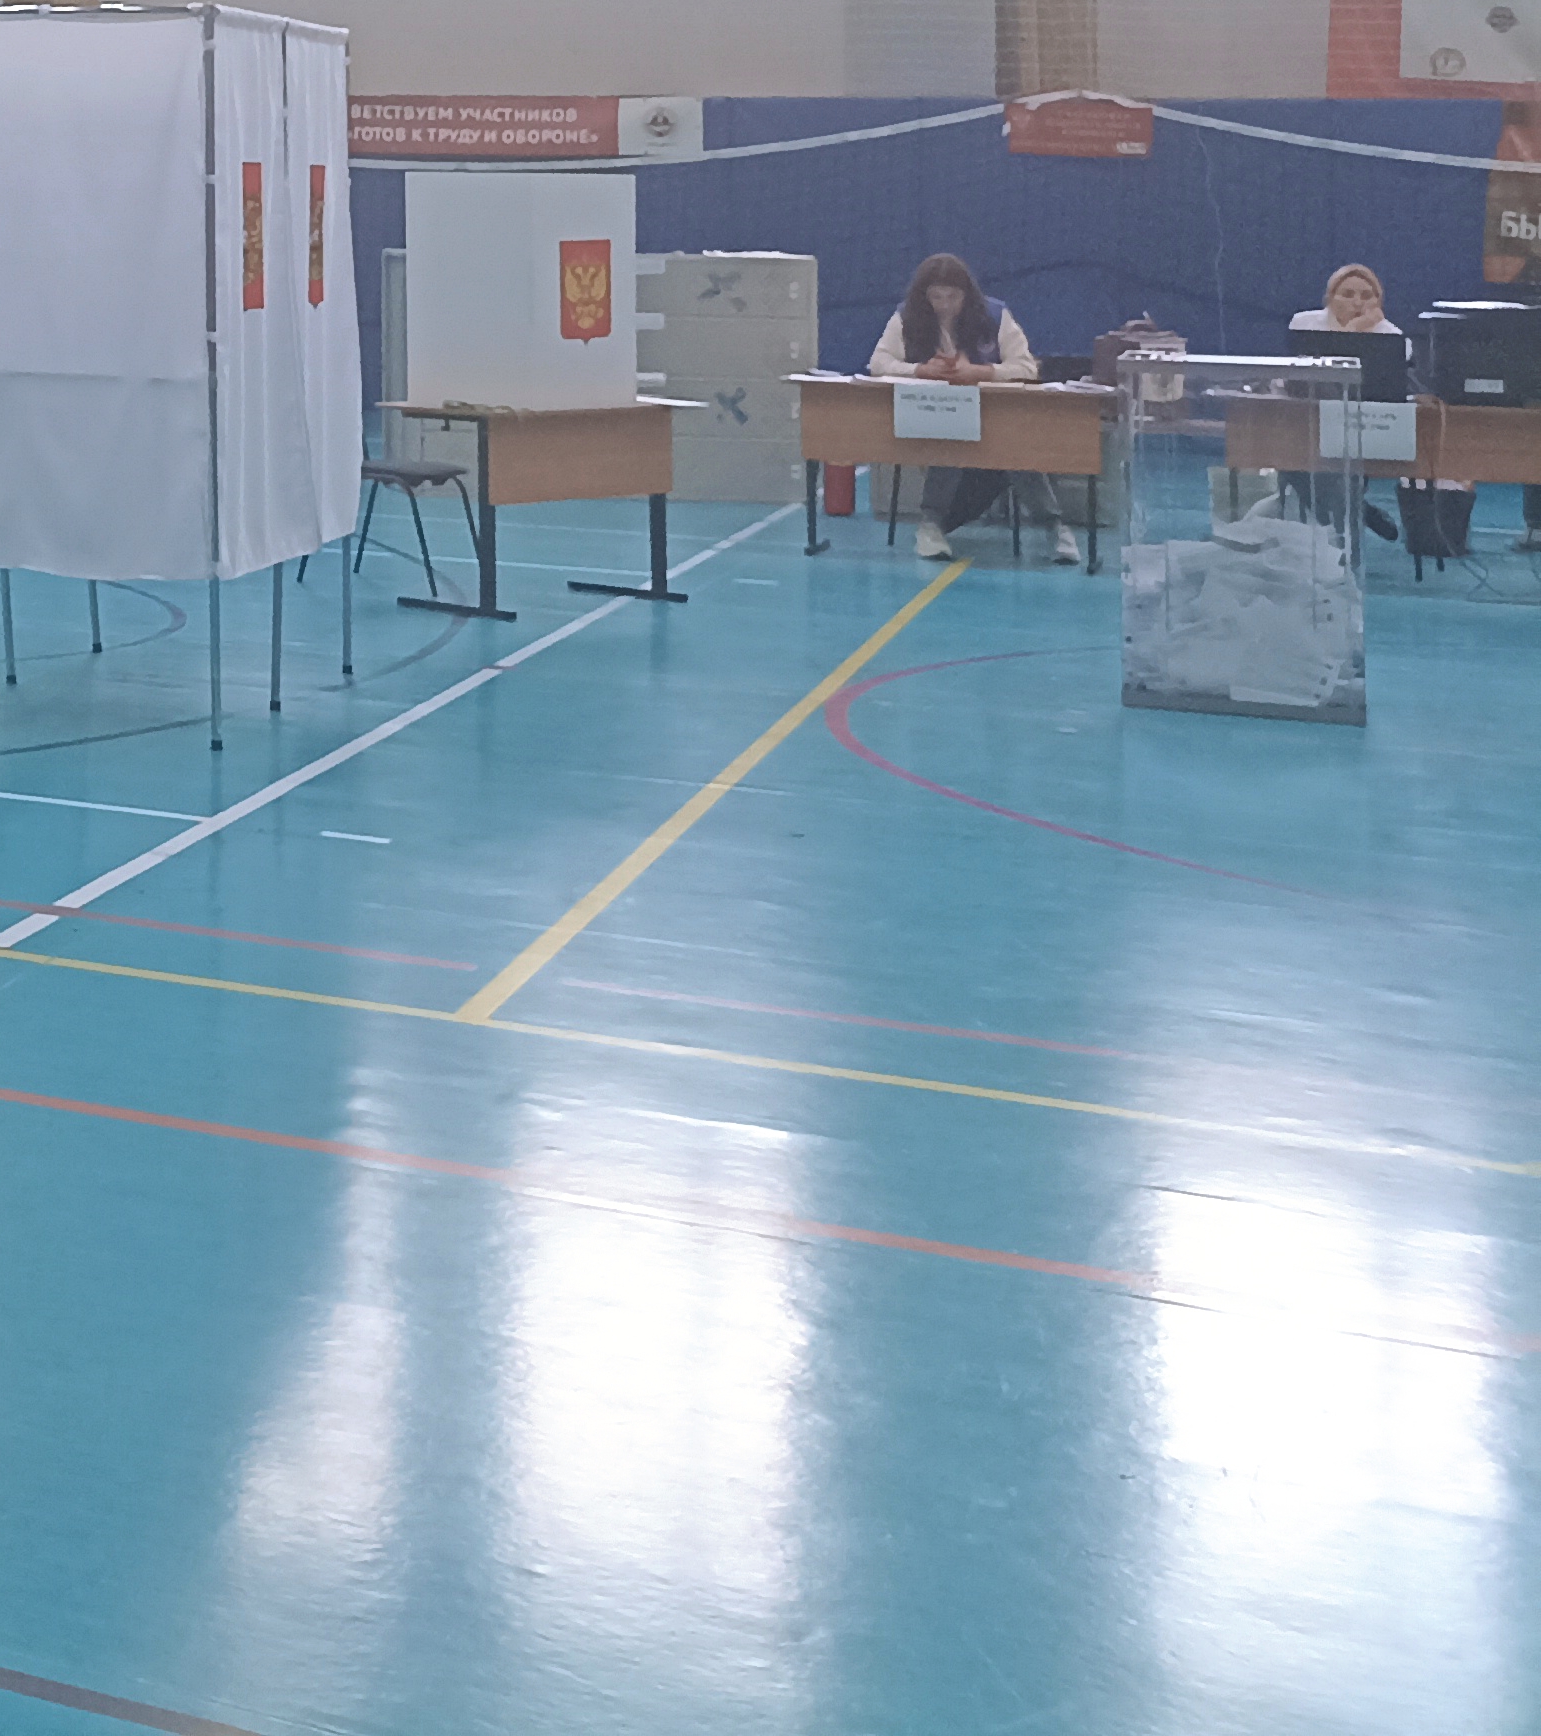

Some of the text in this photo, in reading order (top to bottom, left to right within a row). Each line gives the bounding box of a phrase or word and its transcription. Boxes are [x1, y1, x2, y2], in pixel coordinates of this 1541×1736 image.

[350, 104, 578, 123] ВЕТСТВУЕМ УЧАСТНИКОВ
[411, 128, 422, 143] К
[427, 127, 481, 145] ТРУДУ
[483, 129, 496, 143] И
[1500, 210, 1541, 240] БЫ
